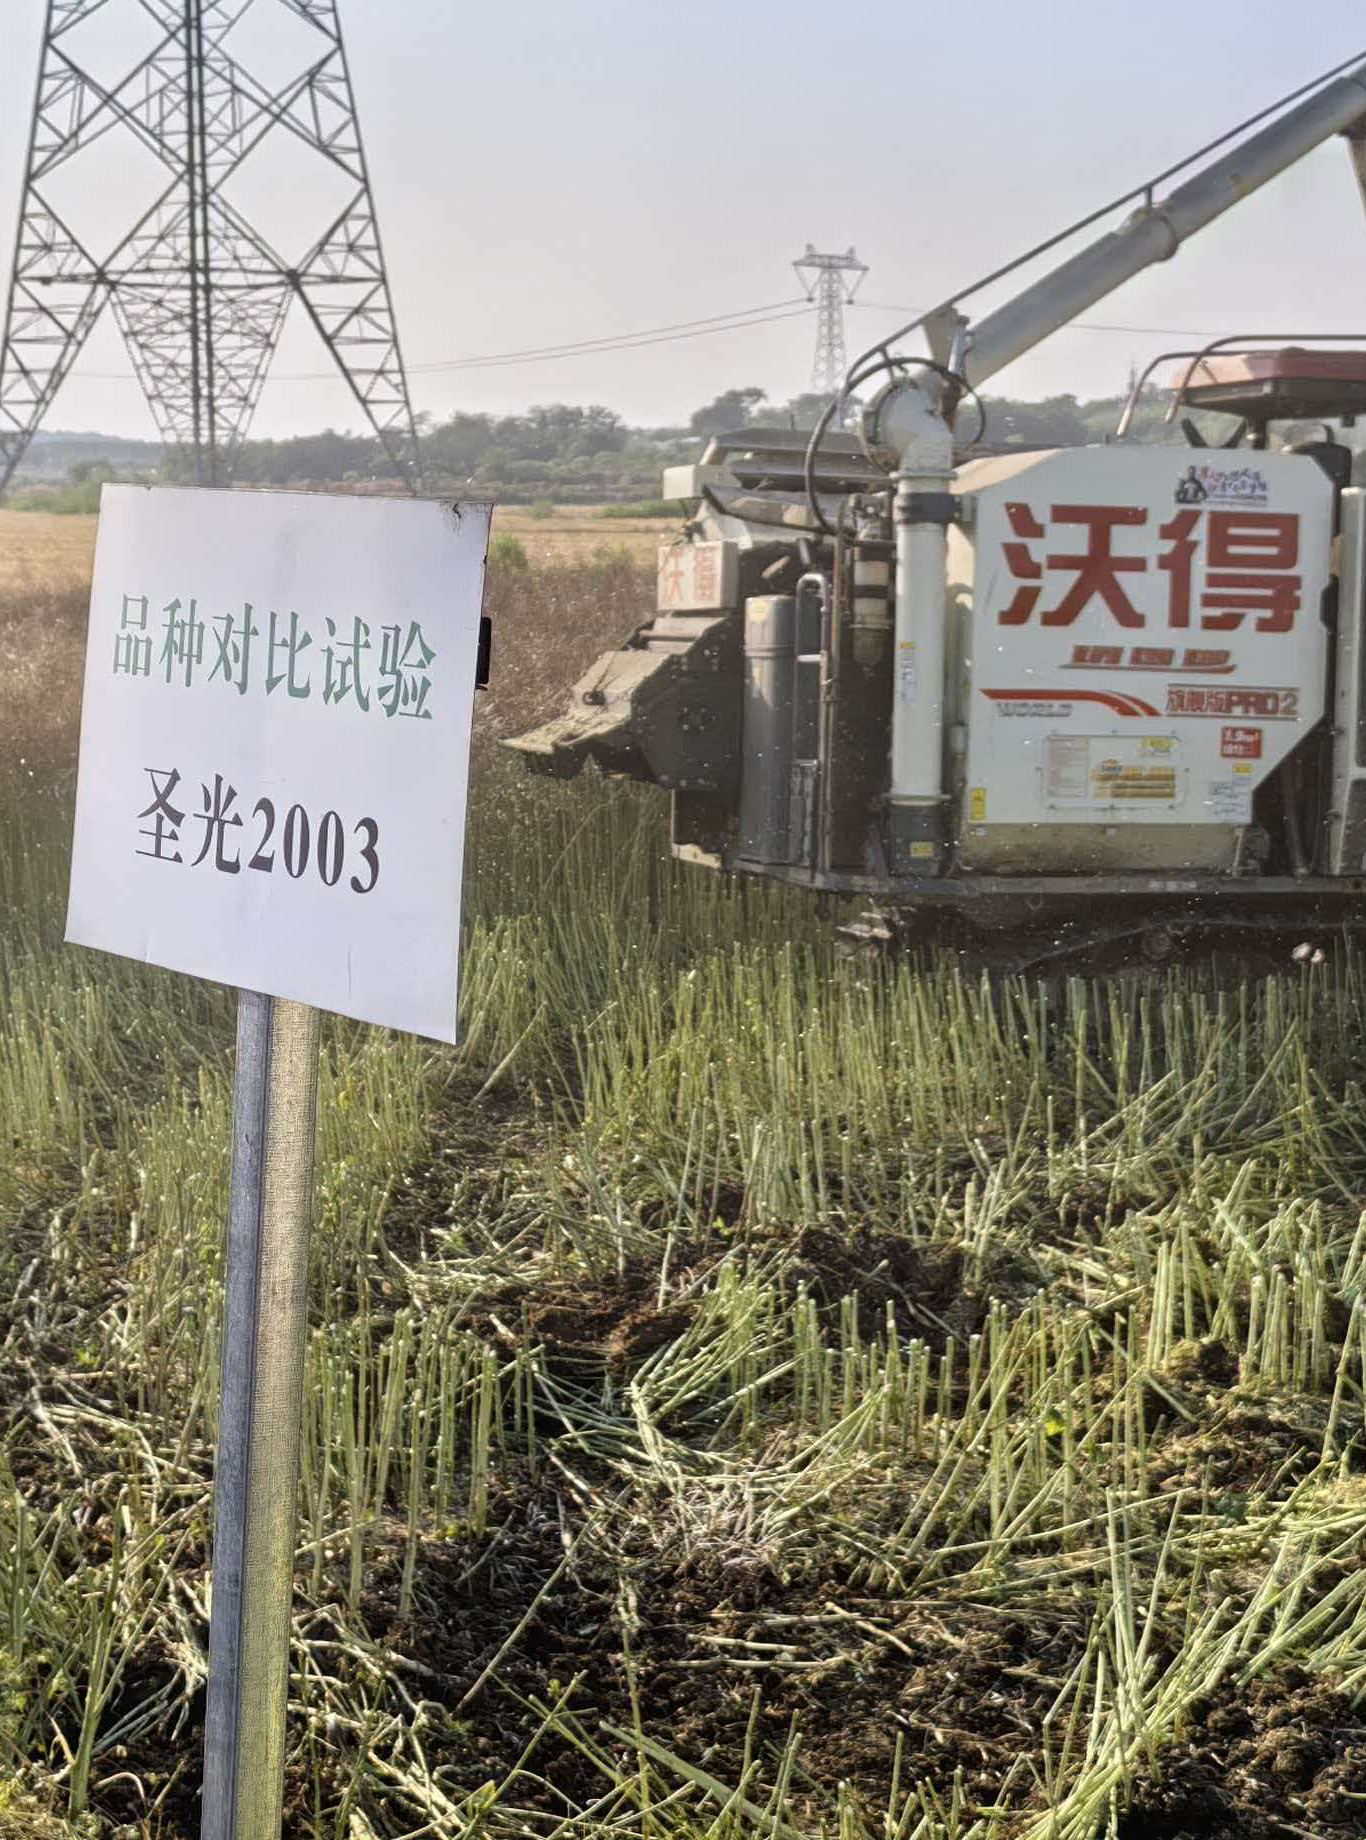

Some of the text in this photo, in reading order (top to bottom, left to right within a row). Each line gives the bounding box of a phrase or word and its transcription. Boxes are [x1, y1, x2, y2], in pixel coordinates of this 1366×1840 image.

[998, 503, 1302, 633] 沃得
[113, 594, 436, 720] 品种对比试验
[135, 767, 380, 894] 圣光2003
